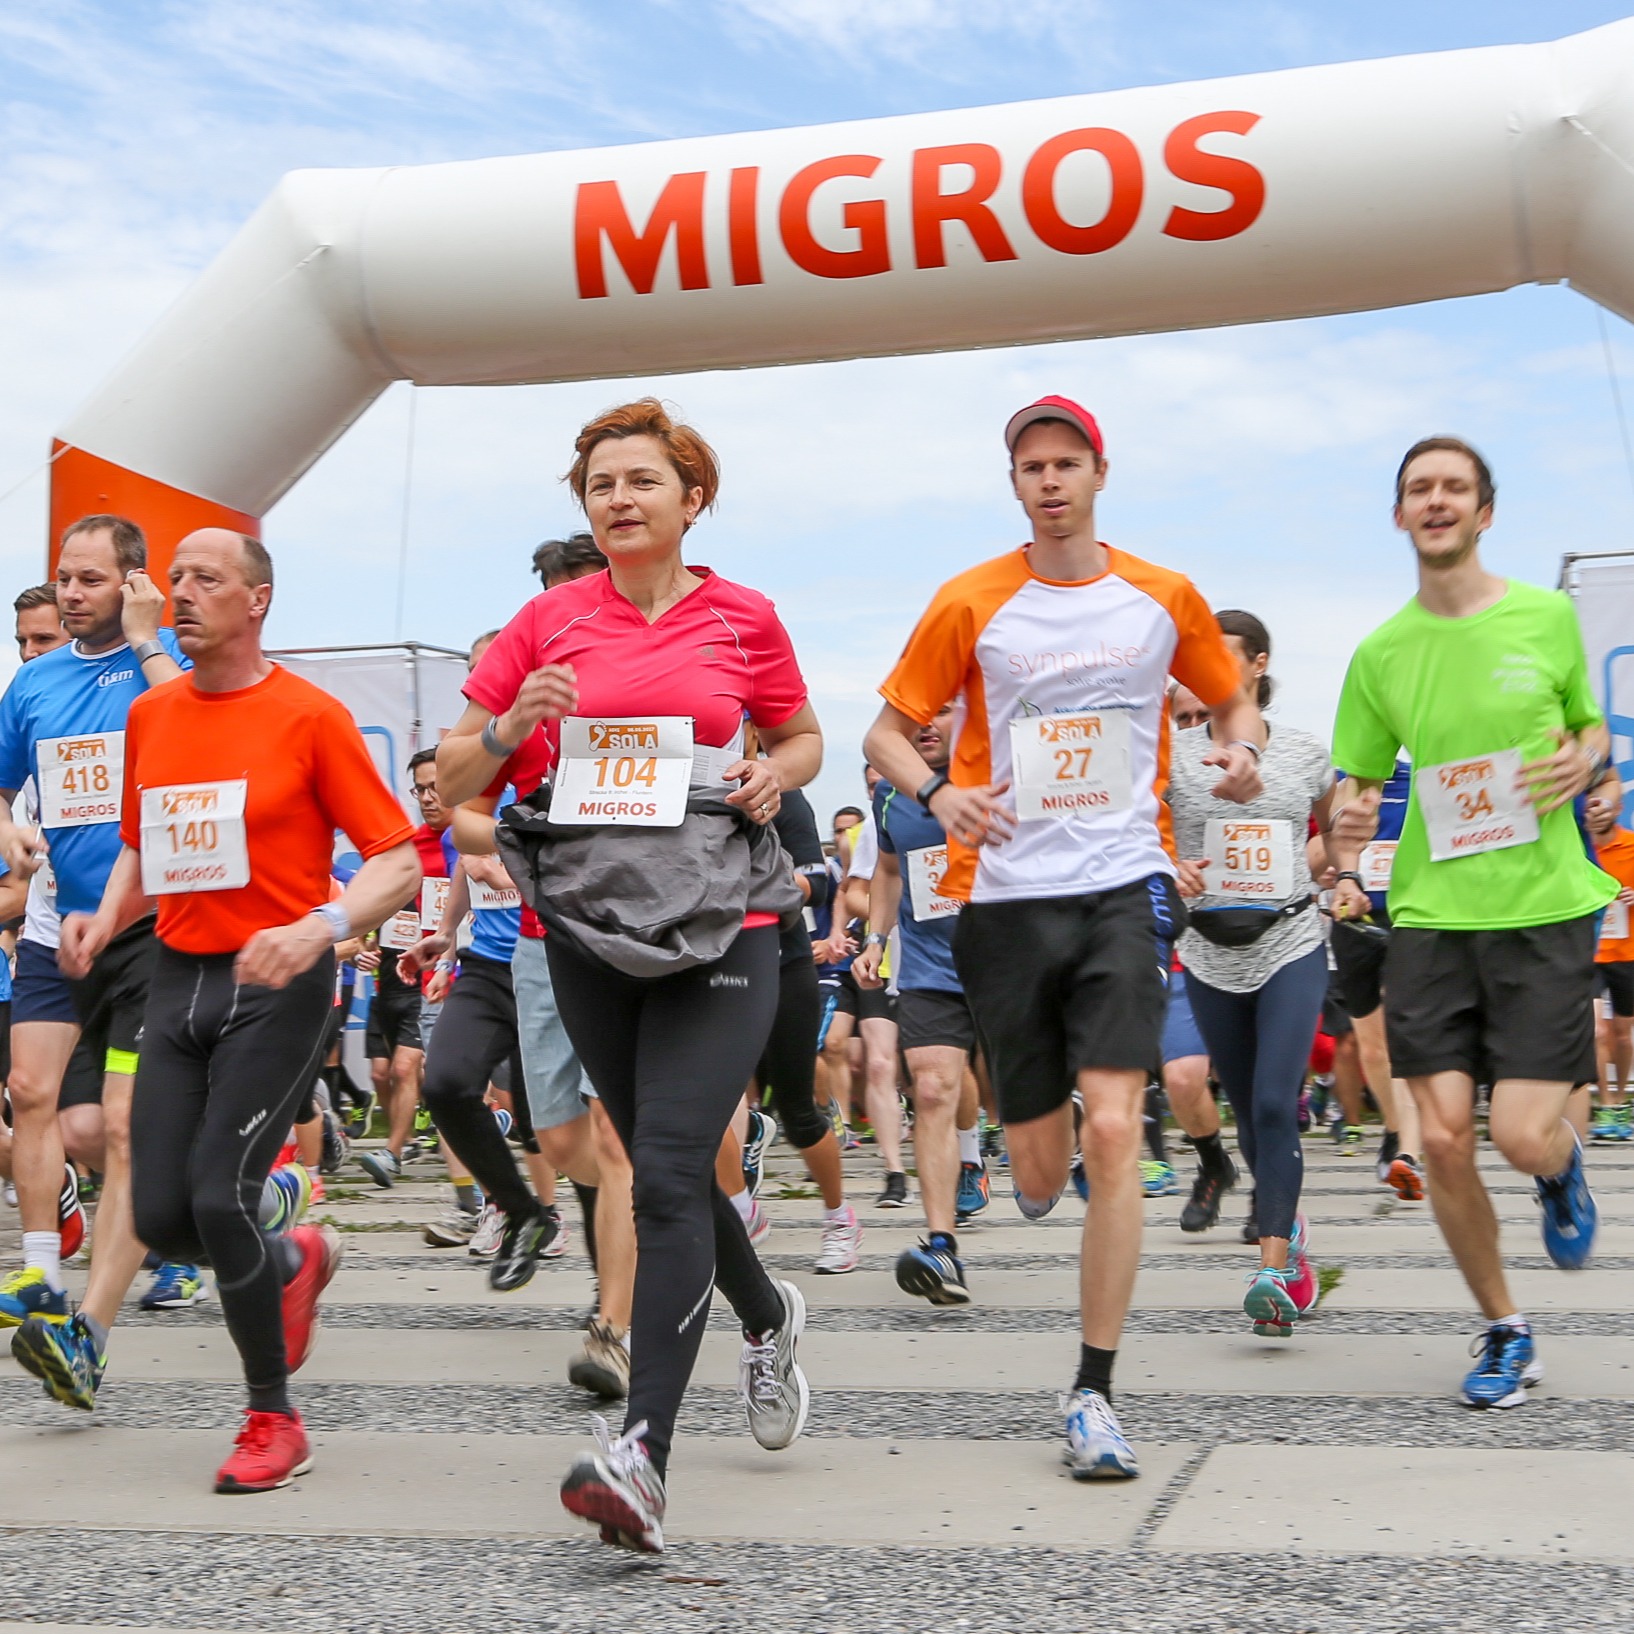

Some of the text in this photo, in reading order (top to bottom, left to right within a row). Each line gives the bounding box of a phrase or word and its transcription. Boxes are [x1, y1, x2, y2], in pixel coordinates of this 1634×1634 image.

[574, 110, 1266, 299] MIGROS
[1008, 640, 1140, 683] synpulse
[97, 669, 134, 687] ti&m
[608, 733, 657, 749] SOLA
[1056, 722, 1101, 741] SOLA
[70, 745, 106, 760] SOLA
[1054, 747, 1092, 780] 27
[62, 764, 110, 794] 418
[594, 756, 657, 787] 104
[578, 802, 657, 816] MIGROS
[1041, 790, 1110, 810] MIGROS
[1455, 788, 1493, 820] 34
[60, 803, 116, 820] MIGROS
[166, 821, 218, 854] 140
[1451, 825, 1515, 849] MIGROS
[1224, 847, 1271, 871] 519
[164, 864, 227, 884] MIGROS
[1221, 880, 1275, 893] MIGROS
